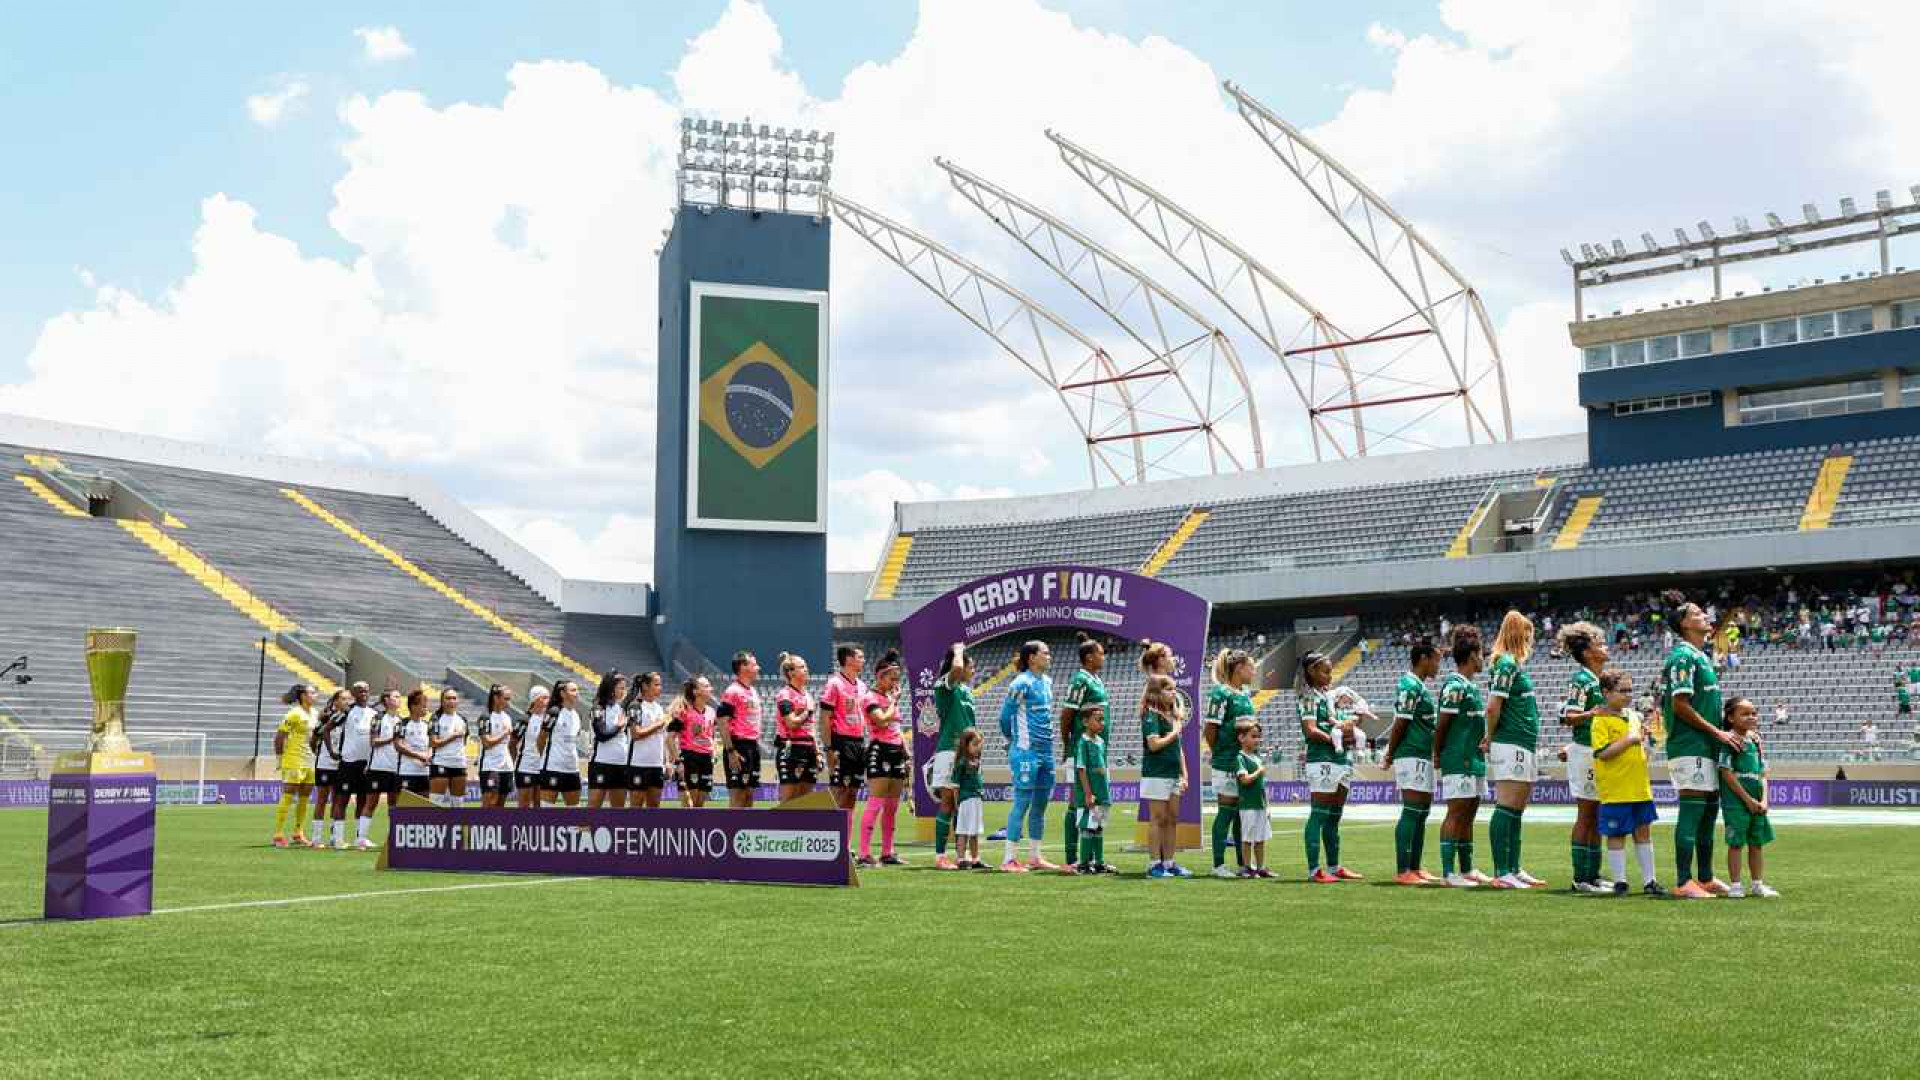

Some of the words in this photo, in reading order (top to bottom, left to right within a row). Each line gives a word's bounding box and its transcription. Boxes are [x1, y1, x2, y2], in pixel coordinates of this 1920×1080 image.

[957, 573, 1035, 621] DERBY
[1042, 571, 1128, 607] FINAL
[1016, 605, 1072, 622] FEMININO
[1351, 785, 1383, 801] ERBY
[1532, 785, 1569, 801] EMIN
[1849, 787, 1920, 805] PAULIST
[395, 824, 447, 849] DERBY
[451, 824, 507, 851] FINAL
[613, 827, 727, 858] FEMININO
[754, 836, 804, 853] Sicredi
[806, 838, 837, 853] 2025
